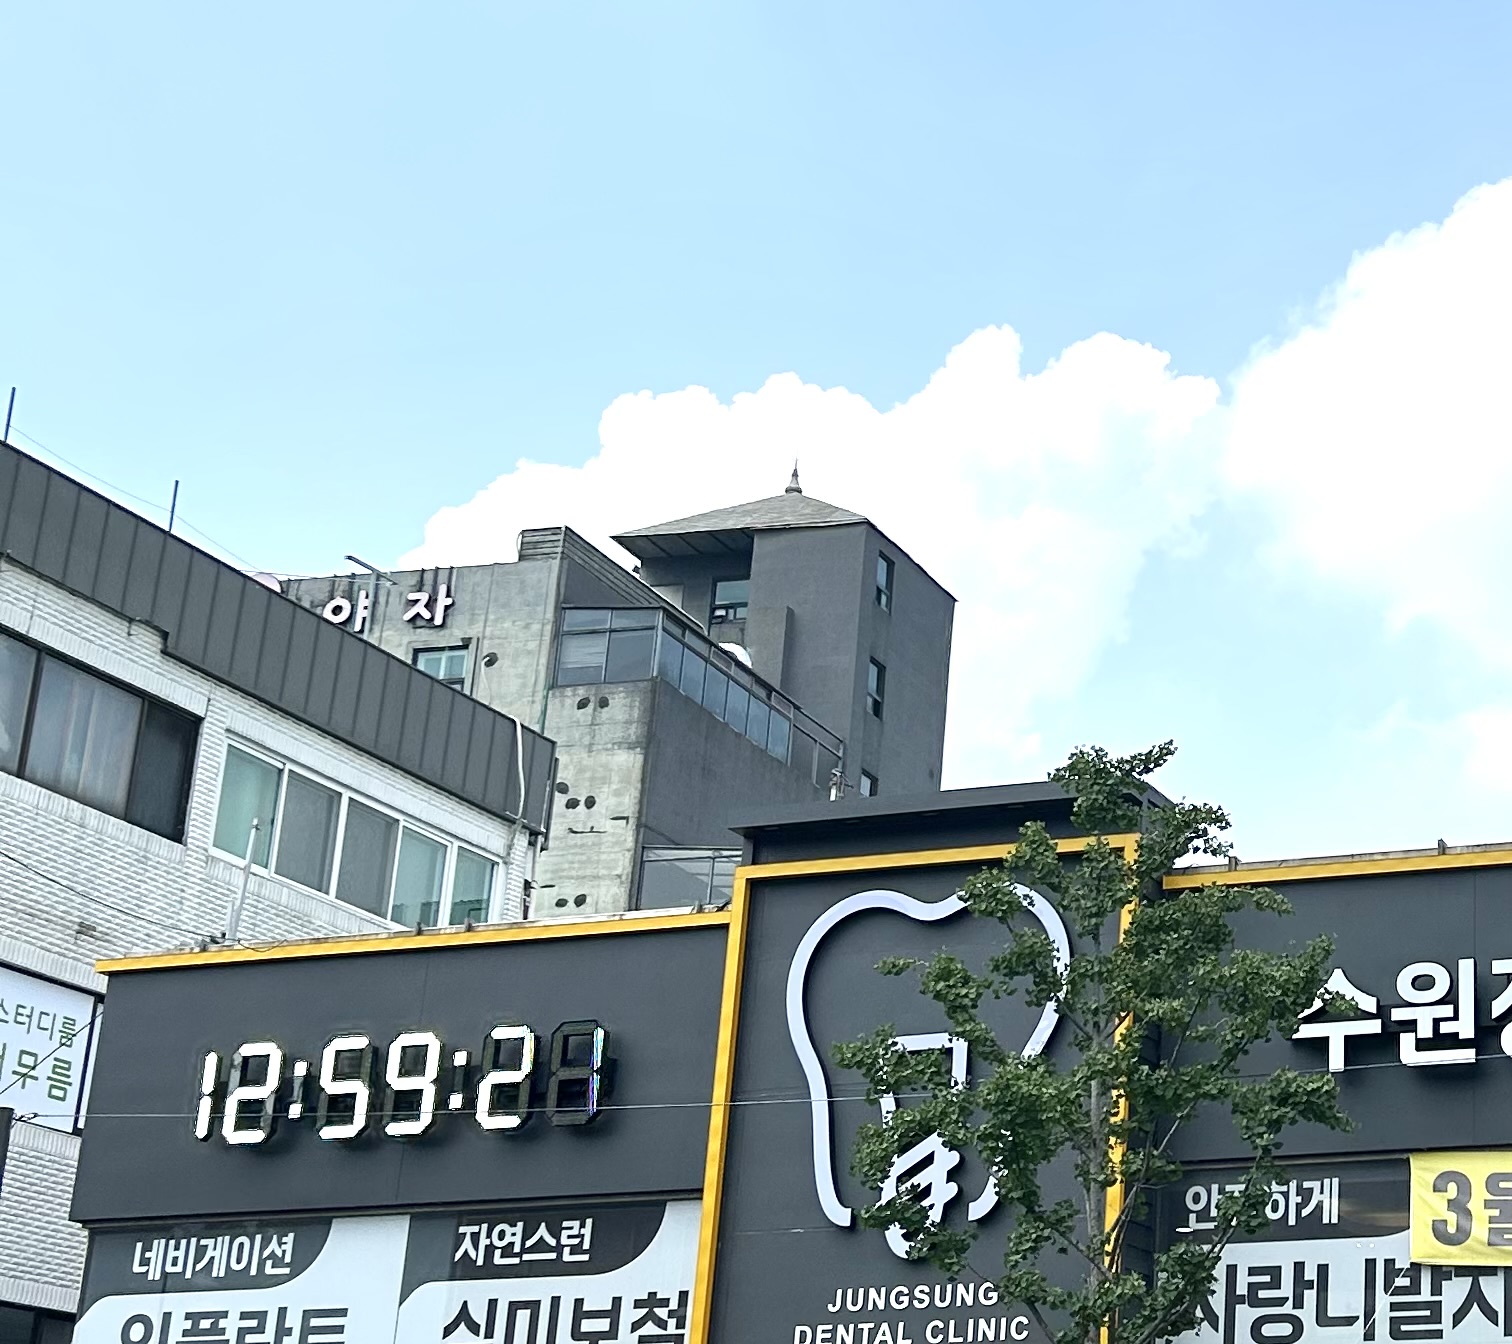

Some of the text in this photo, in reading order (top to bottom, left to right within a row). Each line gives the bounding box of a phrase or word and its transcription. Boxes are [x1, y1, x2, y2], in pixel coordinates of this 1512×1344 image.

[194, 1020, 605, 1145] 12:59:21
[1184, 1176, 1341, 1231] 안하게
[132, 1232, 295, 1281] 네비게이션
[453, 1218, 594, 1265] 자연스런
[827, 1281, 999, 1313] JUNGSUNG
[925, 1315, 1030, 1344] CLINIC
